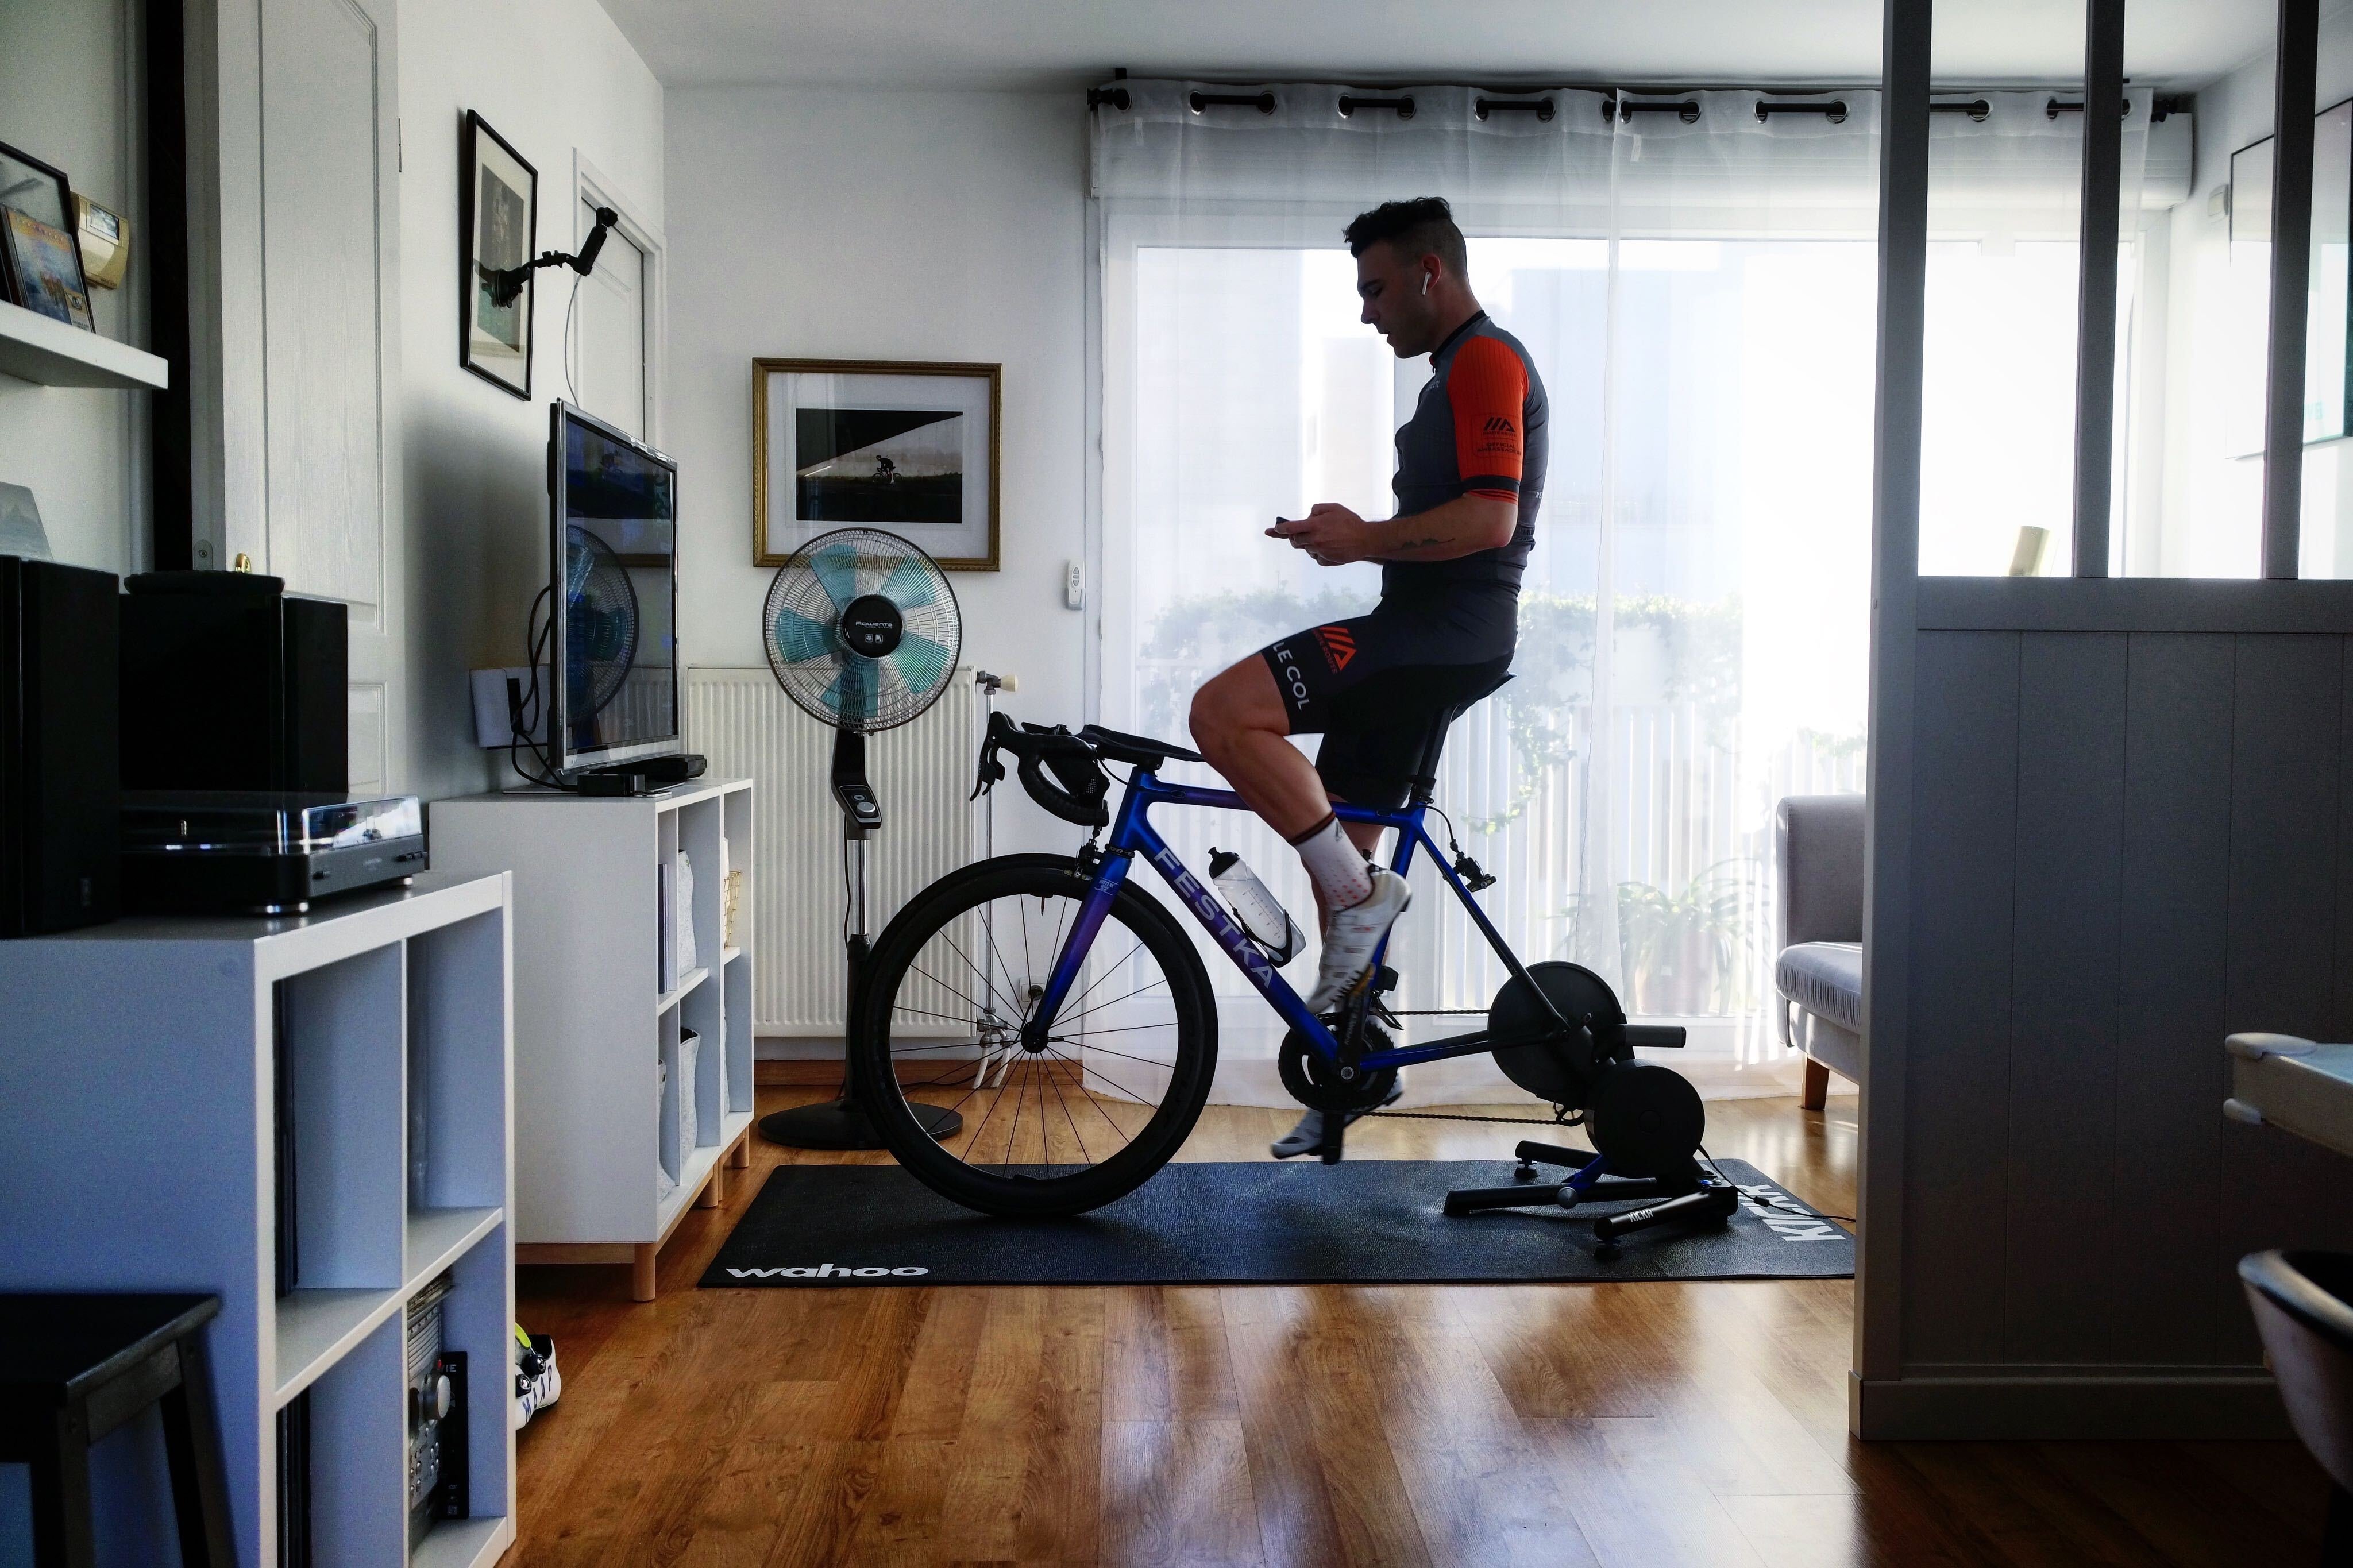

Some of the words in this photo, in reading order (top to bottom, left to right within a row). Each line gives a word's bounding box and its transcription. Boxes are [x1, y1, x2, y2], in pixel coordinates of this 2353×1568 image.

[1272, 642, 1293, 664] LE
[1286, 665, 1310, 712] COL
[1154, 847, 1274, 988] FESTKA
[1626, 1208, 1654, 1223] KICKR
[726, 1263, 929, 1278] wahoo
